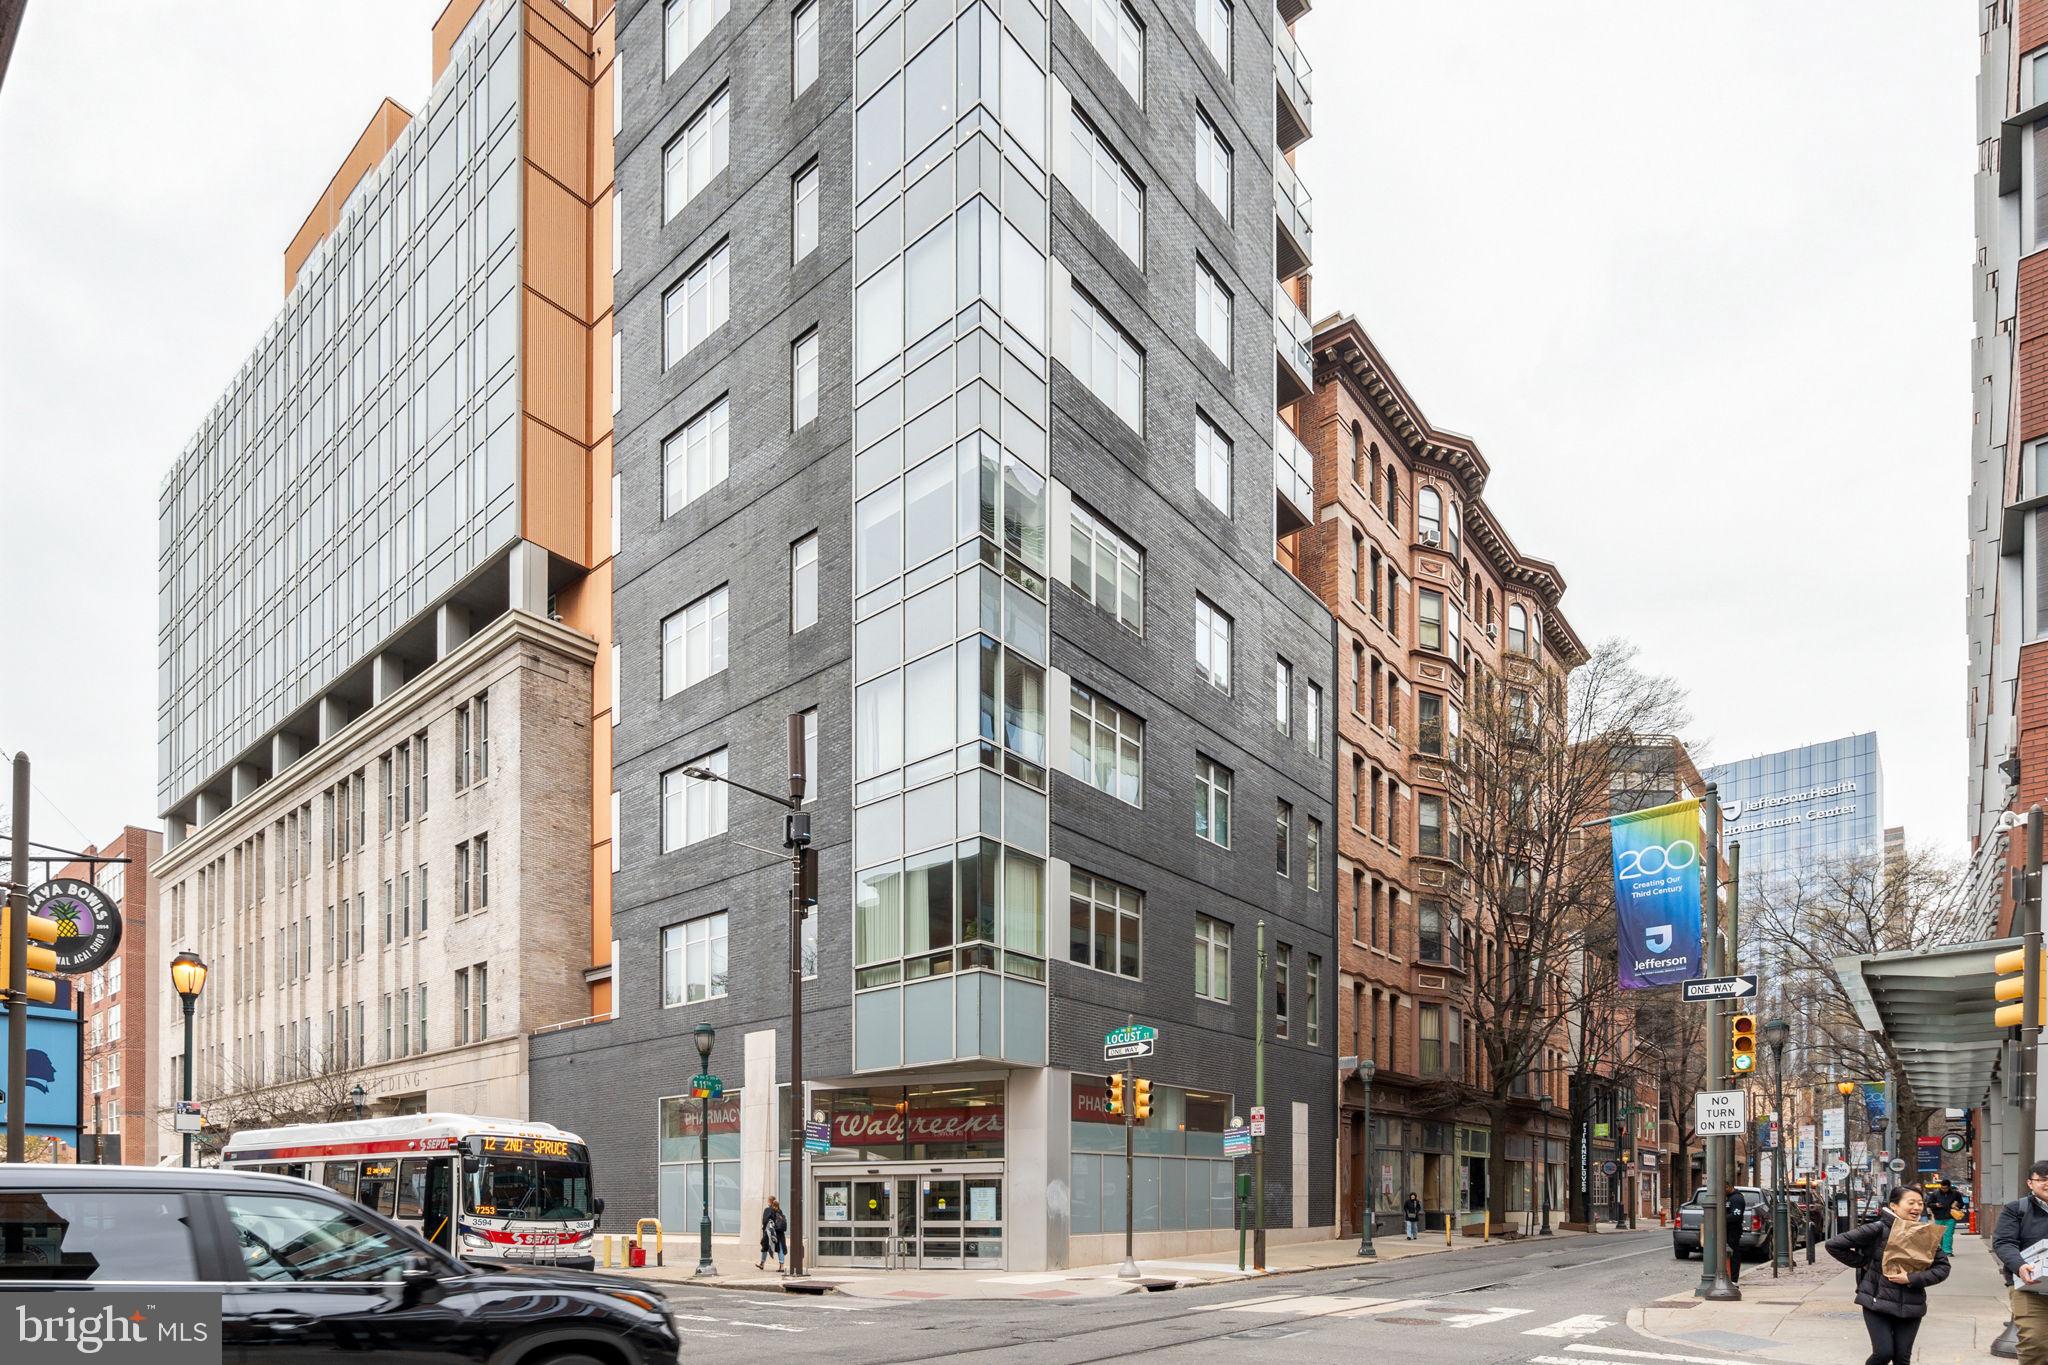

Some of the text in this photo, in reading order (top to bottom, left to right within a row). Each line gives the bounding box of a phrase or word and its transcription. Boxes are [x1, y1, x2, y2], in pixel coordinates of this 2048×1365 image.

[1744, 781, 1856, 812] Jefferson Health
[1722, 804, 1856, 836] Honickman Center
[1619, 840, 1695, 880] 200
[1633, 876, 1680, 890] Creating Our
[1632, 884, 1683, 899] Third Century
[28, 883, 108, 921] LAYA BOWLS
[74, 950, 92, 964] ACAI
[90, 933, 106, 953] SHOP
[1634, 956, 1687, 971] Jefferson
[1690, 983, 1734, 995] ONE WAY
[1106, 1030, 1141, 1044] LOCUST
[1110, 1045, 1138, 1056] ONE WAY
[1712, 1096, 1729, 1105] NO
[1706, 1108, 1735, 1118] TURN
[835, 1113, 1004, 1141] Walgreens
[1700, 1120, 1741, 1130] ON RED
[427, 1138, 449, 1149] SEPTA
[484, 1136, 496, 1150] 12
[504, 1138, 523, 1152] 2ND
[533, 1141, 568, 1156] SPRUCE
[1947, 1137, 1960, 1149] P
[475, 1205, 496, 1215] 7253
[472, 1218, 492, 1226] 3594
[576, 1221, 591, 1229] 3594
[525, 1233, 560, 1245] SEPTA
